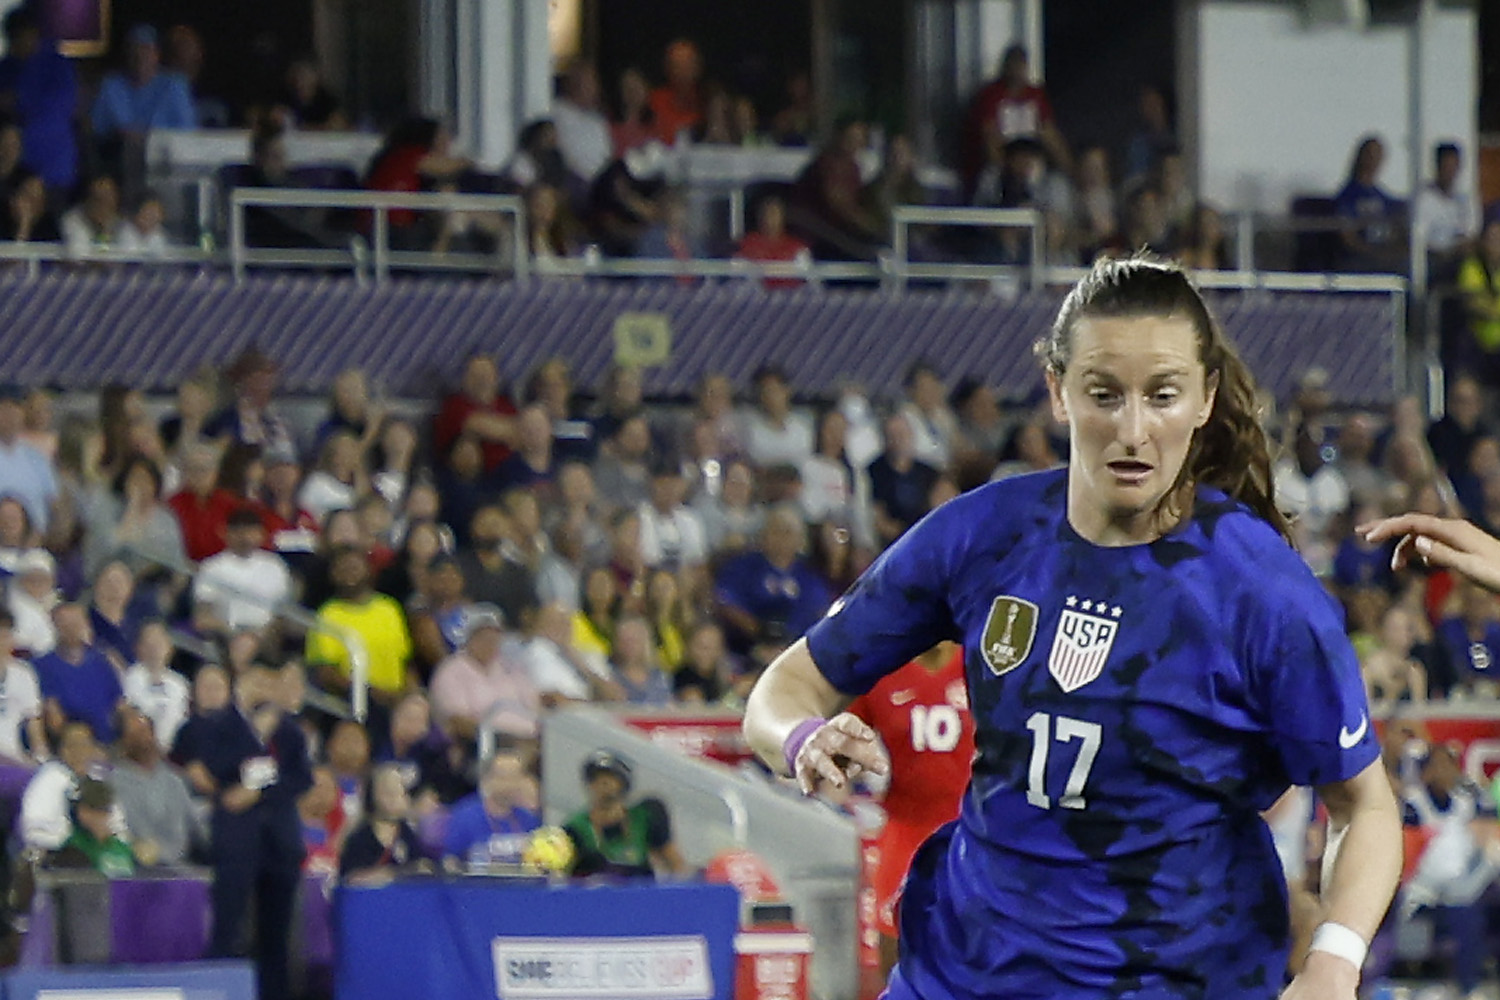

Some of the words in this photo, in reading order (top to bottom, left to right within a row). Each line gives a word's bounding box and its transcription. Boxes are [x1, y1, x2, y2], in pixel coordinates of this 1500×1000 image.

[1062, 614, 1112, 648] USA
[910, 704, 962, 752] 10
[1026, 711, 1102, 810] 17
